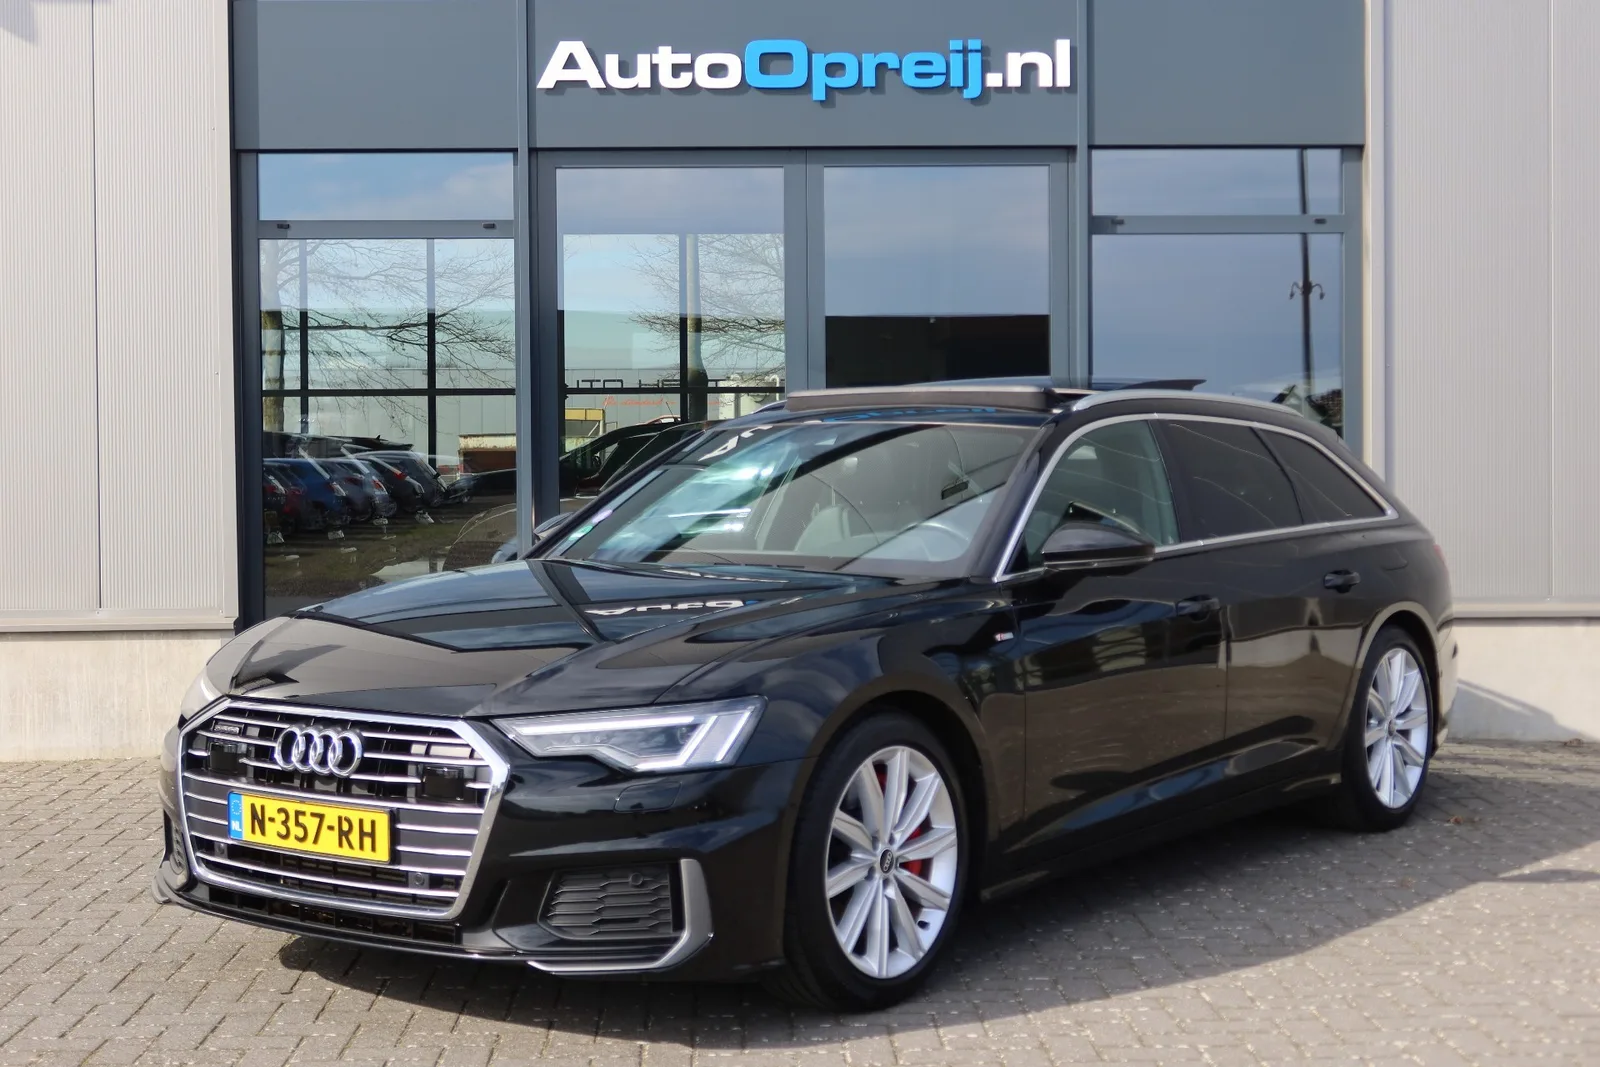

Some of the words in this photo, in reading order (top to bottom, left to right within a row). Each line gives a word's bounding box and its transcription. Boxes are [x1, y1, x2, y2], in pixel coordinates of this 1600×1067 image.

[537, 39, 1071, 101] AutoOpreij.nl
[231, 820, 243, 832] NL
[250, 802, 376, 853] N-357-RH
